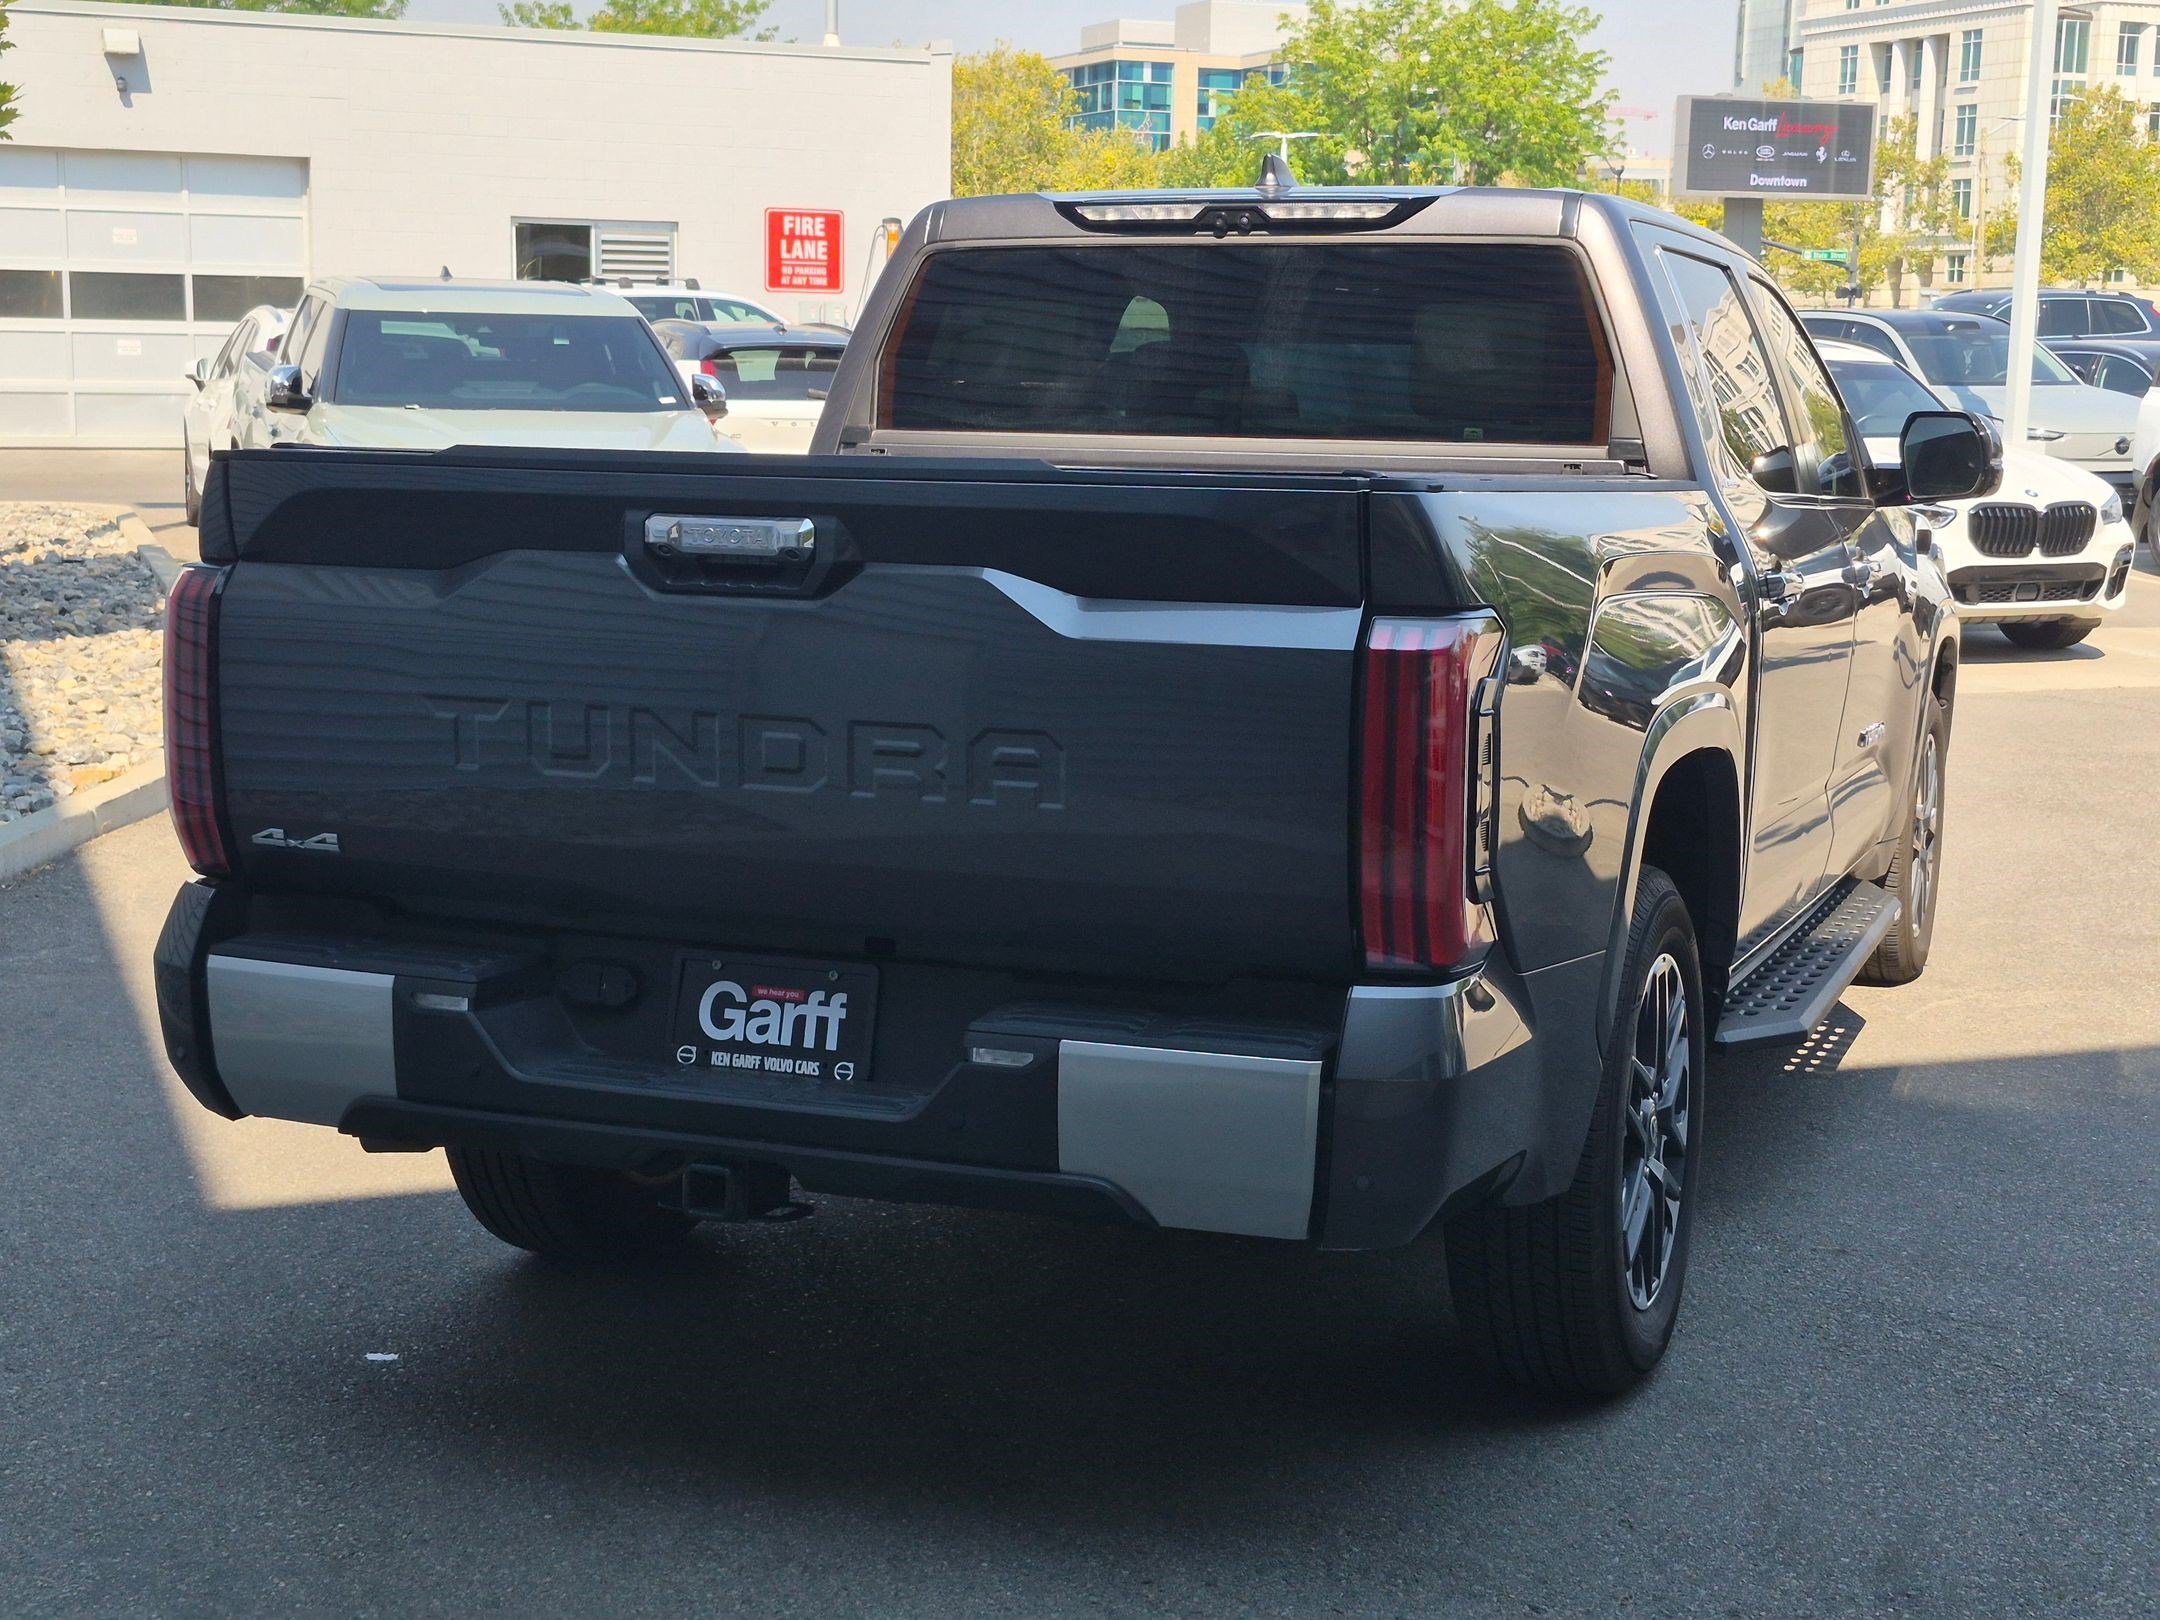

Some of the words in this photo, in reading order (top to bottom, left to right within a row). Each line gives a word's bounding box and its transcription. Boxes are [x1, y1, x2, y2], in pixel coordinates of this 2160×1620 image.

[1723, 116, 1747, 132] Ken
[1747, 117, 1778, 132] Garff
[1750, 174, 1807, 188] Downtown
[783, 215, 826, 237] FIRE
[780, 238, 828, 260] LANE
[780, 276, 791, 285] AT
[791, 276, 808, 286] ANY
[808, 277, 828, 286] TIME
[781, 266, 793, 275] NO
[794, 266, 827, 276] PARKING
[690, 527, 766, 545] TOYOTA
[423, 694, 1066, 810] TUNDRA
[251, 828, 340, 852] 4x4
[757, 987, 769, 995] we
[769, 987, 785, 997] hear
[785, 989, 800, 1000] you
[698, 980, 848, 1051] Garff
[711, 1051, 731, 1067] KEN
[732, 1053, 762, 1070] GARFF
[763, 1057, 793, 1073] VOLVO
[794, 1060, 820, 1076] CARS
